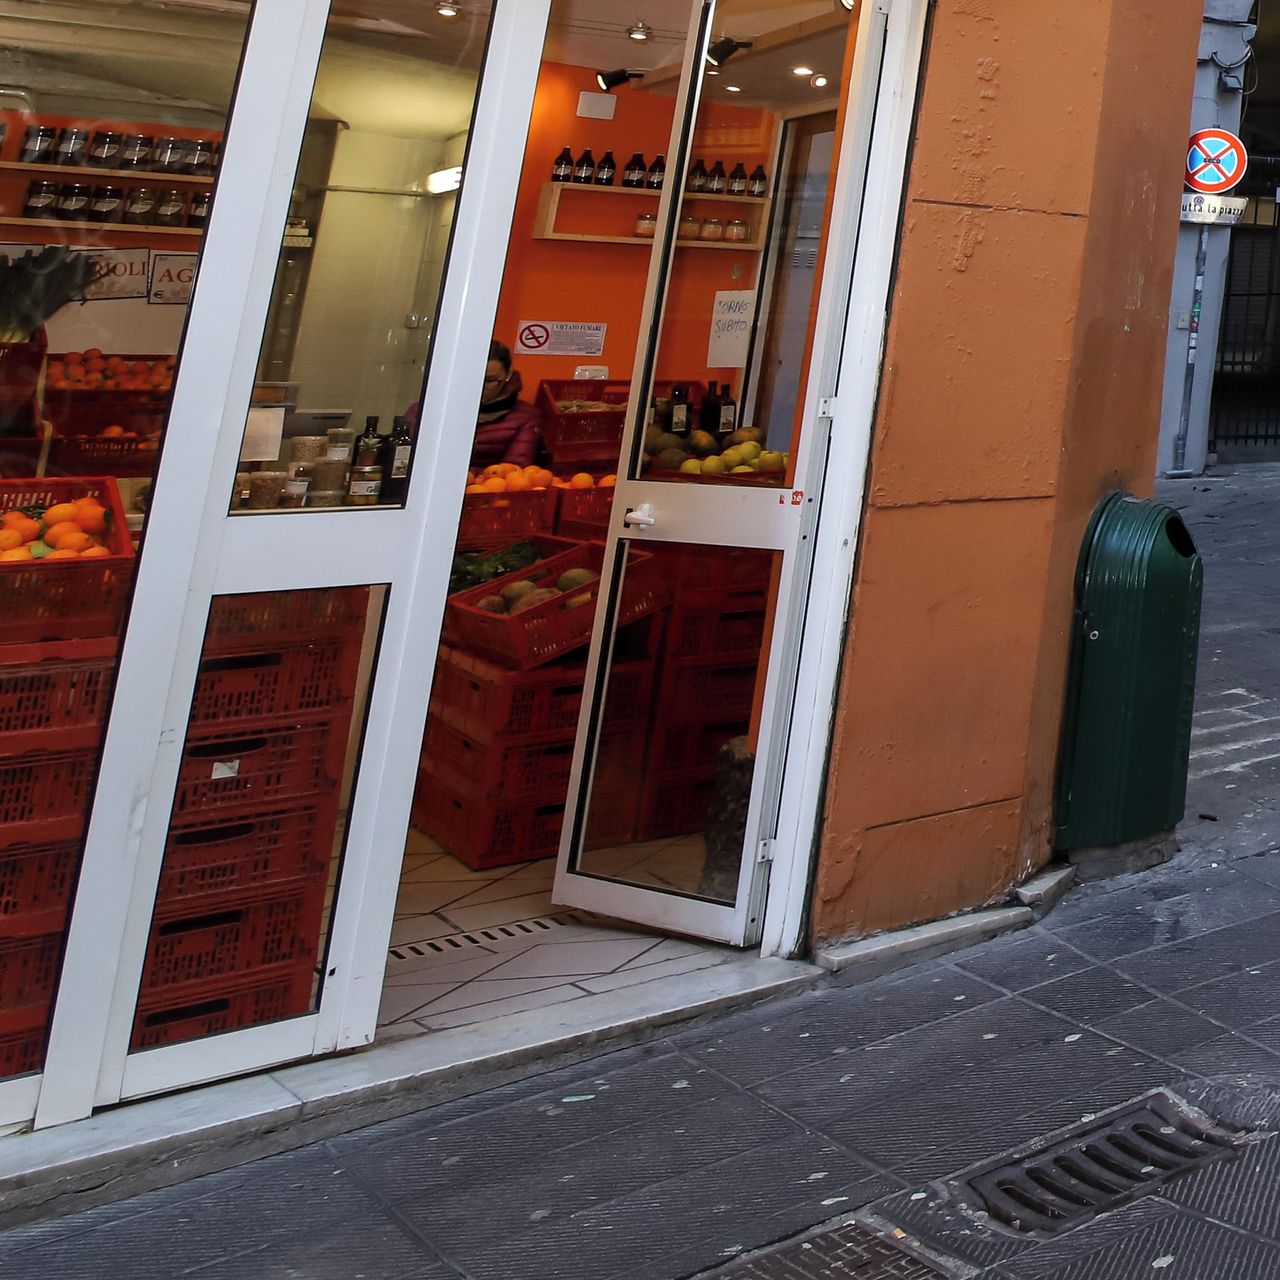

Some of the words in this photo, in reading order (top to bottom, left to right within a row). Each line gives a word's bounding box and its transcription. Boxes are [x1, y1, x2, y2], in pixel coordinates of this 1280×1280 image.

[1182, 202, 1203, 213] utta
[1208, 203, 1217, 214] la
[158, 268, 193, 283] AG
[555, 323, 578, 331] VIETATO
[578, 324, 602, 332] FUMARE
